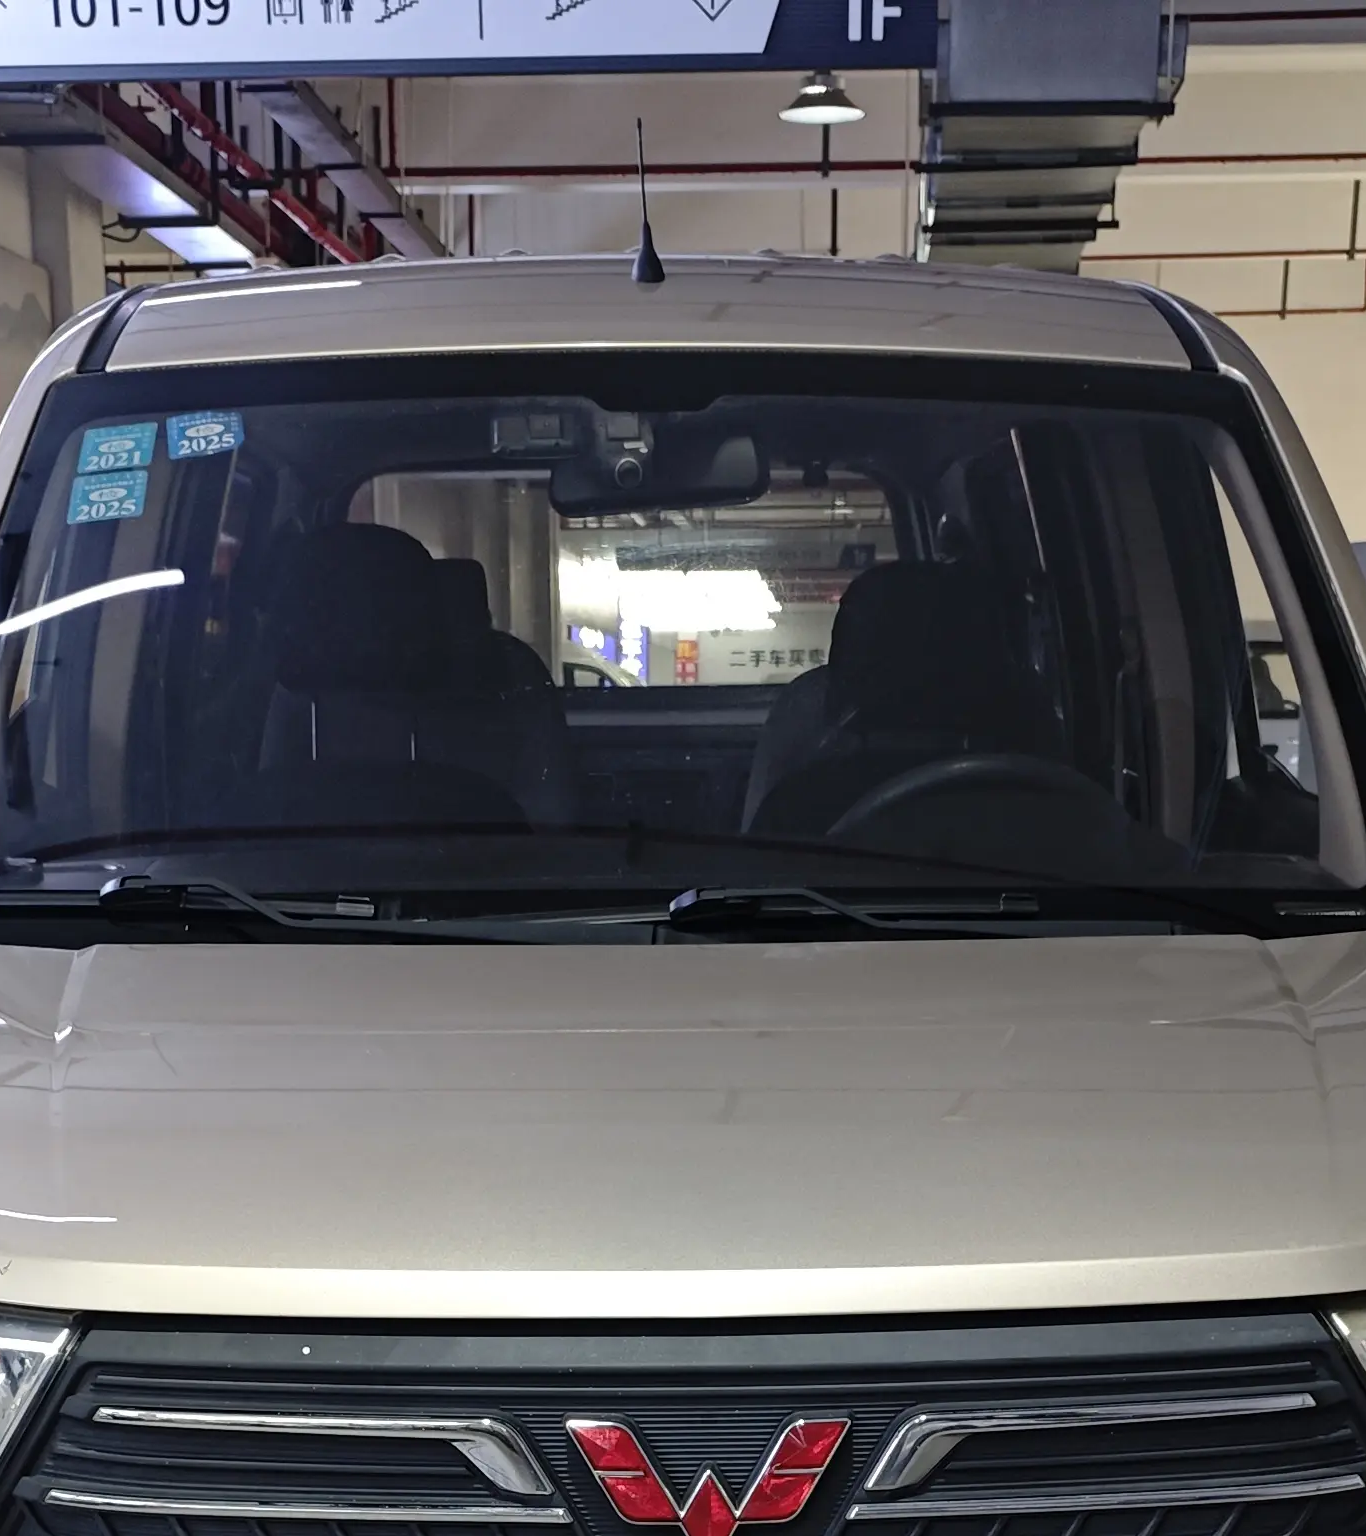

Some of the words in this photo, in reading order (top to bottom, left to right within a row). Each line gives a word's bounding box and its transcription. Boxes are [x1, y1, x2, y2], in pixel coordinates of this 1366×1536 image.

[177, 432, 236, 456] 2025
[85, 450, 143, 471] 2021
[75, 498, 137, 522] 2025
